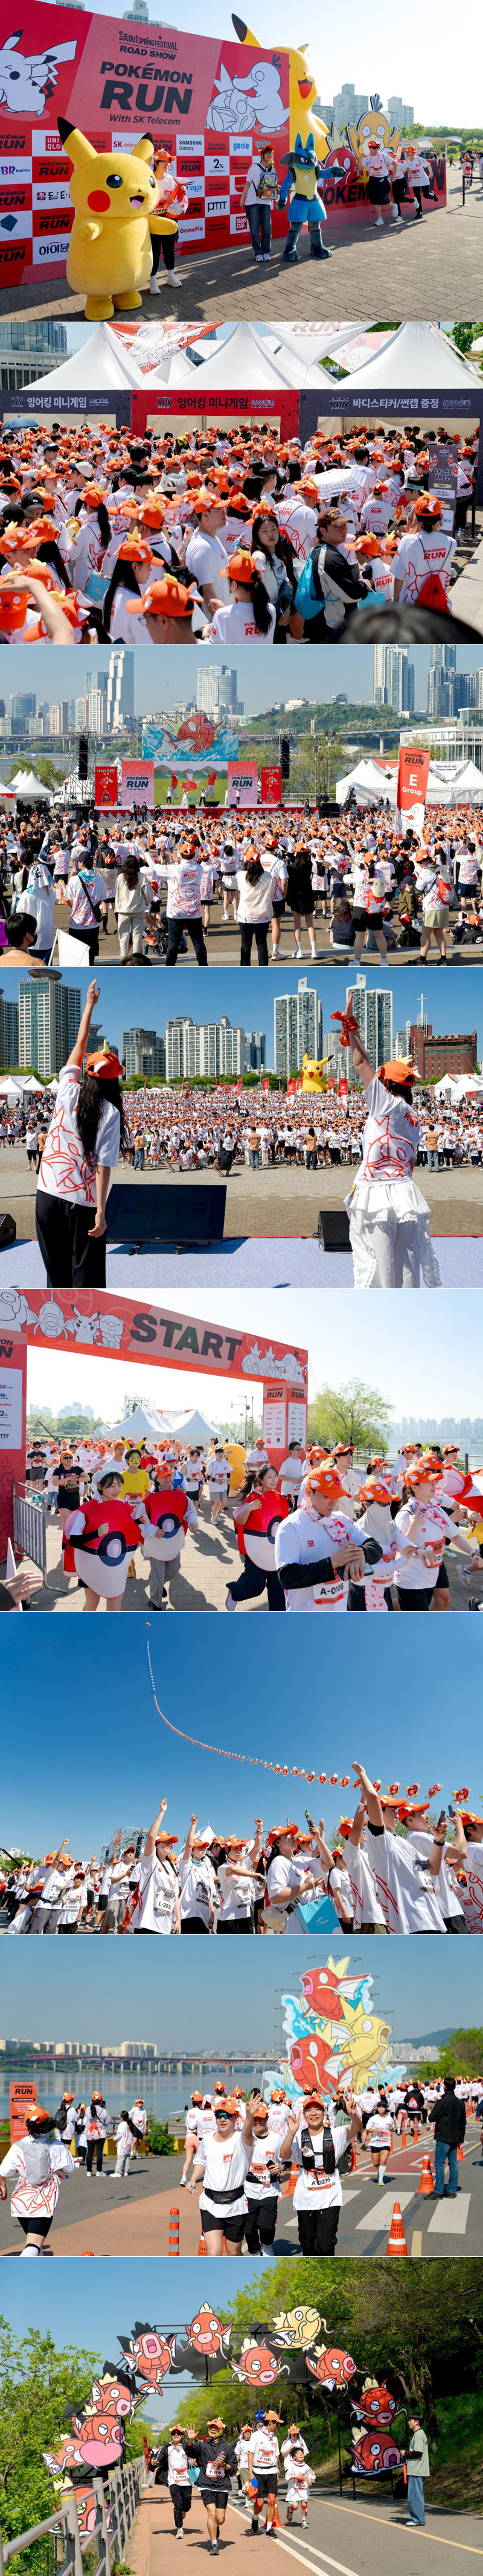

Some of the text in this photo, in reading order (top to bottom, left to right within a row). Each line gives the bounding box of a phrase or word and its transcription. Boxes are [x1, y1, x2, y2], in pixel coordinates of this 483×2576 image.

[138, 37, 155, 46] SPRING
[155, 40, 178, 51] FESTIVAL
[120, 45, 176, 60] ROAD SHOW
[100, 61, 193, 84] POKÉMON
[100, 80, 193, 114] RUN
[109, 114, 131, 122] With
[147, 116, 181, 125] Telecom
[233, 142, 249, 151] genie
[213, 159, 224, 169] 2%
[39, 167, 69, 176] RUN
[39, 219, 70, 230] RUN
[291, 322, 343, 332] RUN
[27, 396, 87, 408] 잉어킹 미니게임
[178, 397, 206, 409] 잉어킹
[209, 397, 248, 409] 미니게임
[353, 398, 418, 409] 바디스티커/썬캡
[421, 398, 439, 409] 증정
[423, 552, 446, 560] RUN
[376, 577, 392, 587] RUN
[245, 628, 261, 636] RU
[405, 757, 424, 765] RUN
[409, 774, 417, 786] E
[402, 787, 422, 796] Group
[403, 1112, 418, 1127] RUN
[130, 1313, 242, 1361] START
[320, 1583, 344, 1595] A-0106
